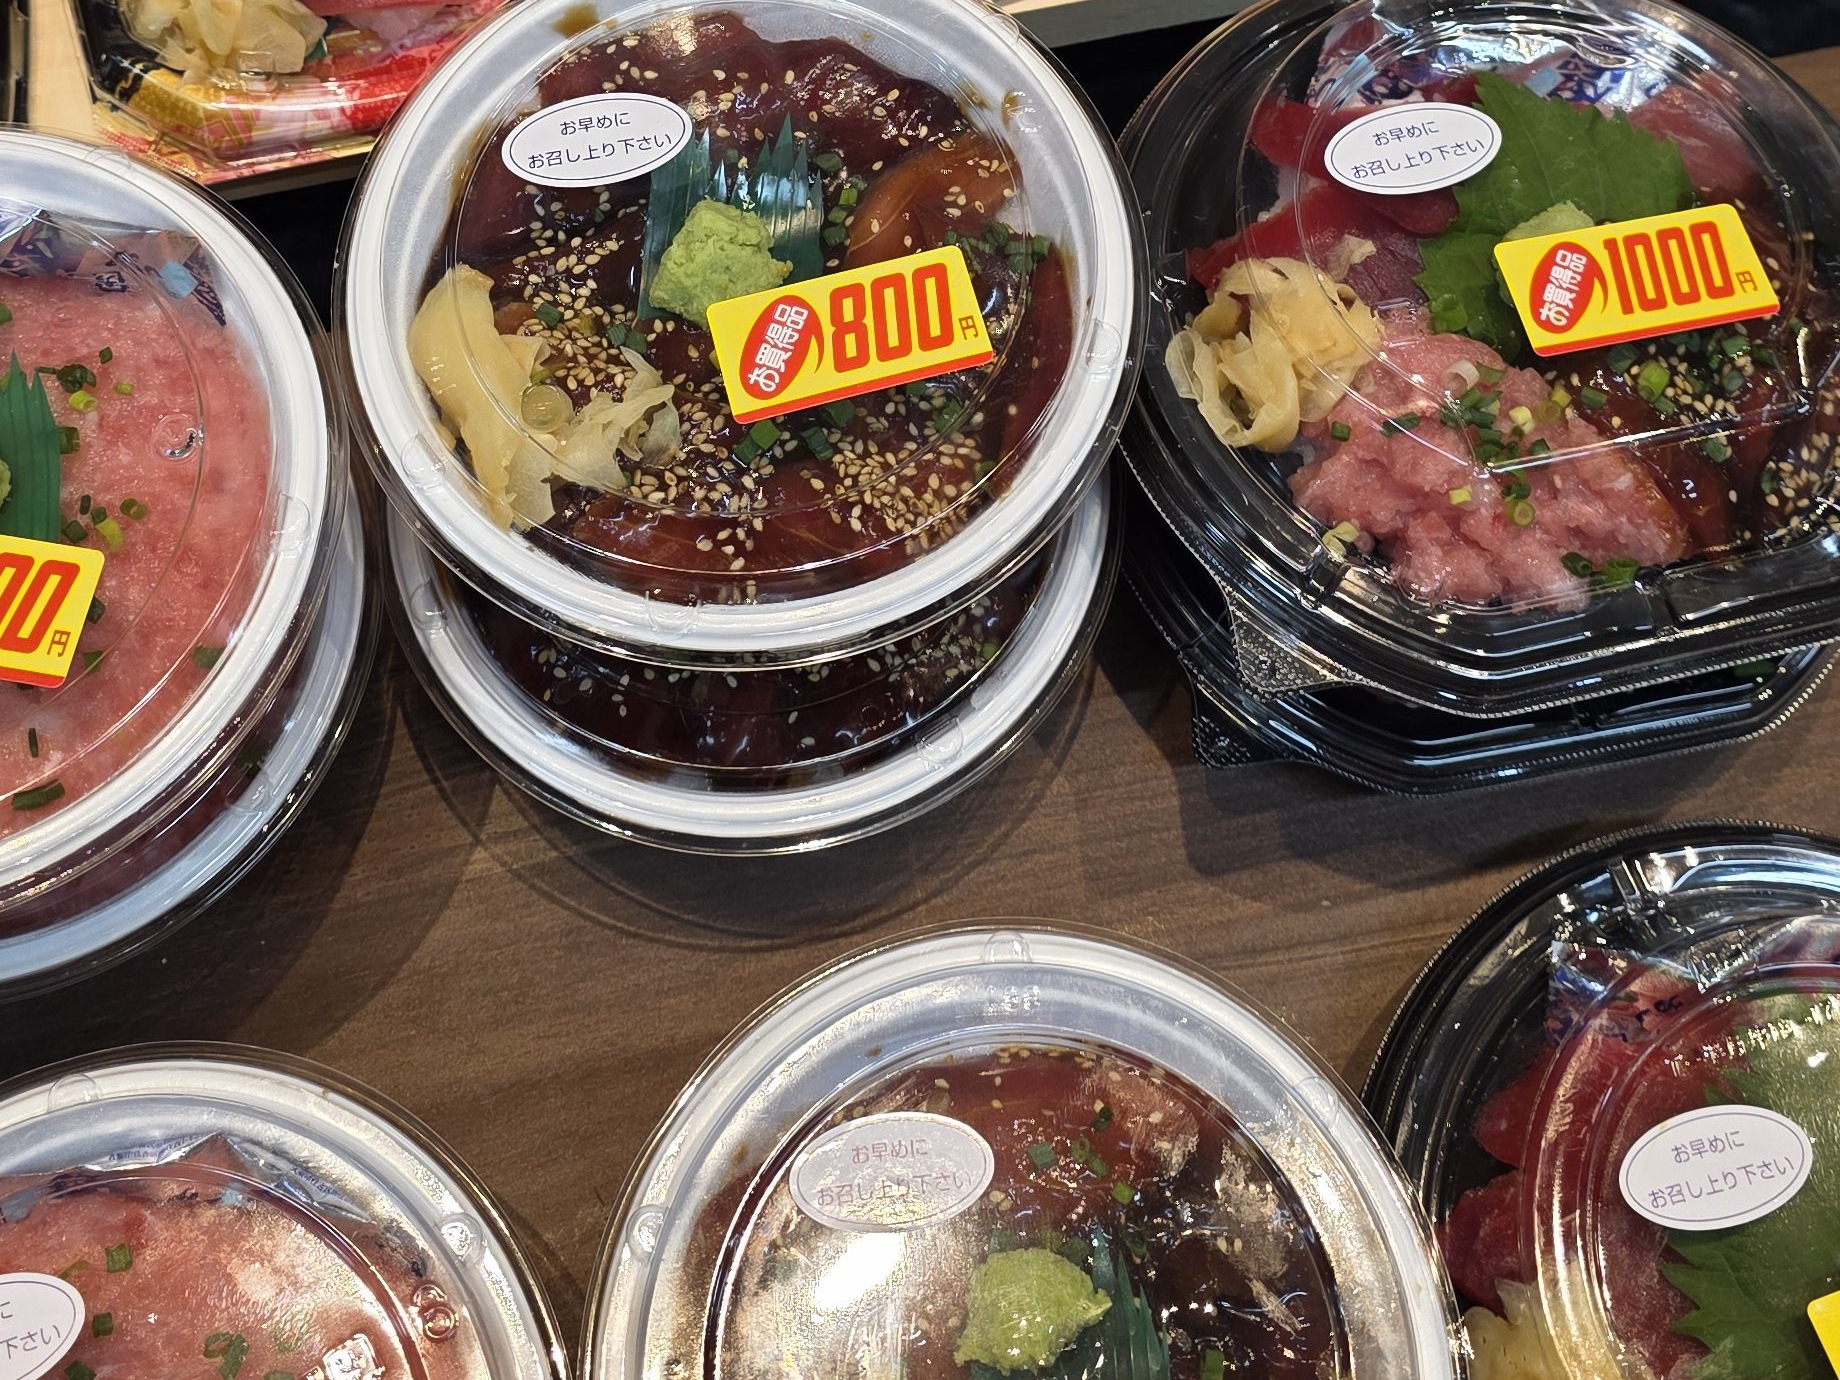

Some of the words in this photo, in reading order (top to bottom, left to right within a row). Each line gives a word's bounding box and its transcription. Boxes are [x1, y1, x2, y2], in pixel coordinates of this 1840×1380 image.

[560, 110, 631, 137] お早めに
[1373, 119, 1441, 147] お早めに
[528, 131, 673, 170] お召し上り下さい
[1352, 137, 1485, 180] お召し上り下さい
[1539, 247, 1588, 326] お買得品
[747, 303, 810, 392] お買得品
[852, 1139, 929, 1164] お早めに
[1671, 1131, 1746, 1164] お早めに
[817, 1170, 973, 1207] お召し上り下さい
[1649, 1156, 1794, 1209] お召し上り下さい
